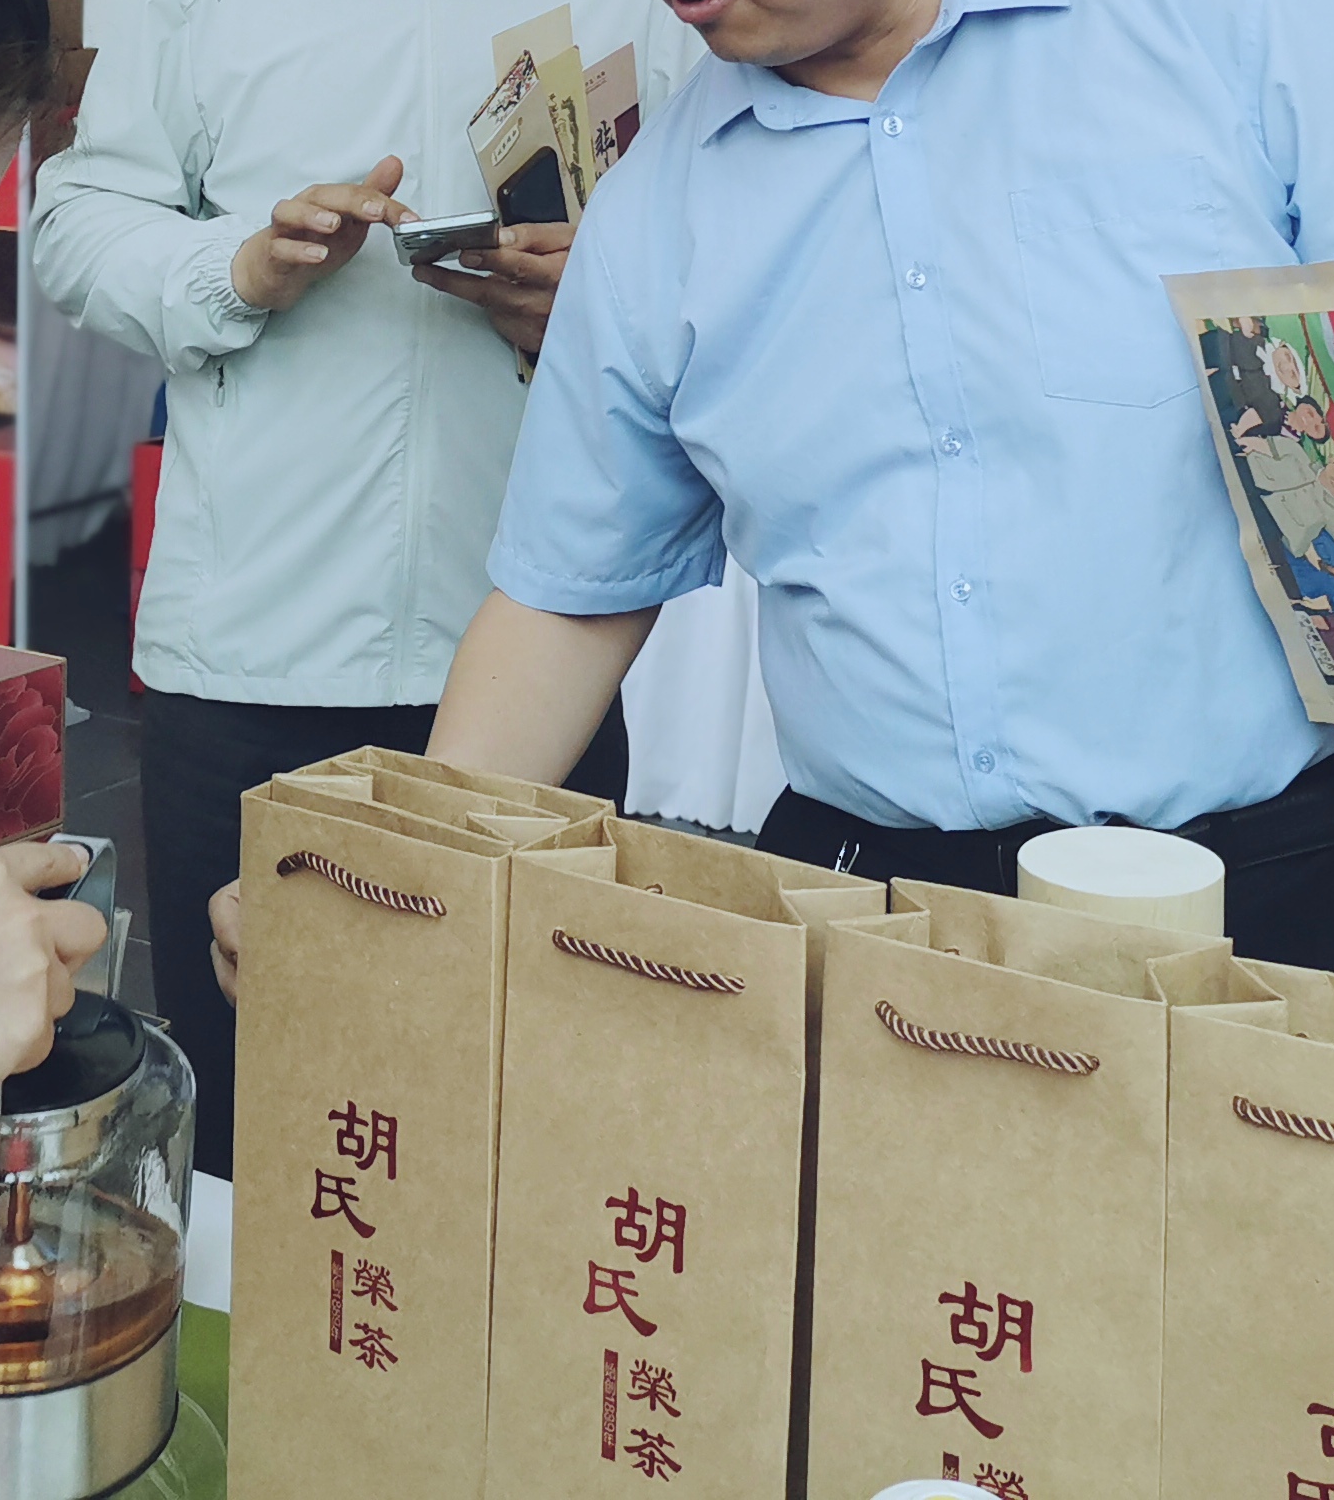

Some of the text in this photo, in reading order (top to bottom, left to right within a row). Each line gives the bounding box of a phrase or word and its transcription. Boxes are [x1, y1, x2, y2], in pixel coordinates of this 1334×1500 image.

[310, 1100, 398, 1239] 胡氏
[582, 1186, 687, 1337] 胡氏
[915, 1281, 1033, 1439] 胡氏
